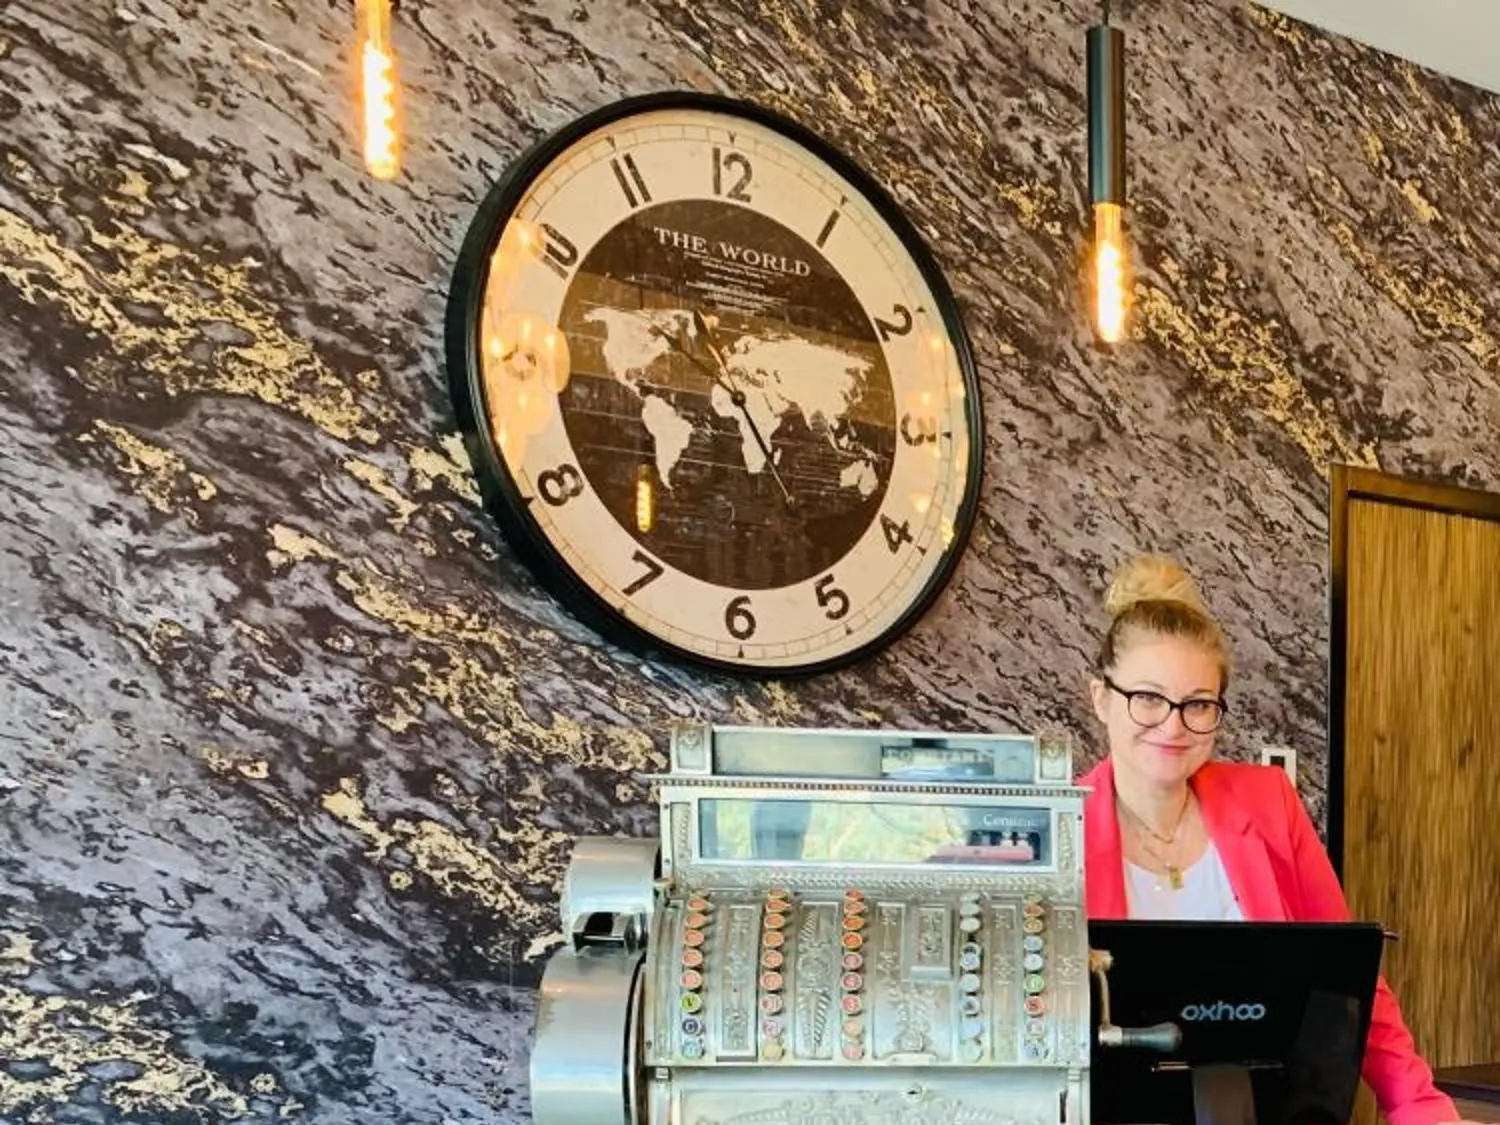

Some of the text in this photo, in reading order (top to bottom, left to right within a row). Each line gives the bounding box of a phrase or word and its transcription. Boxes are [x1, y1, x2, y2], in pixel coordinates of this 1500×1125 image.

[610, 153, 652, 208] 11
[713, 148, 753, 203] 12
[816, 210, 840, 248] 1
[536, 223, 579, 281] 10
[653, 226, 707, 253] THE
[720, 241, 811, 277] WORLD
[874, 303, 913, 342] 2
[900, 412, 937, 446] 3
[537, 463, 585, 507] 8
[880, 513, 914, 554] 4
[622, 552, 665, 598] 7
[815, 573, 850, 621] 5
[725, 596, 757, 640] 6
[1181, 1000, 1266, 1021] oxhoo
